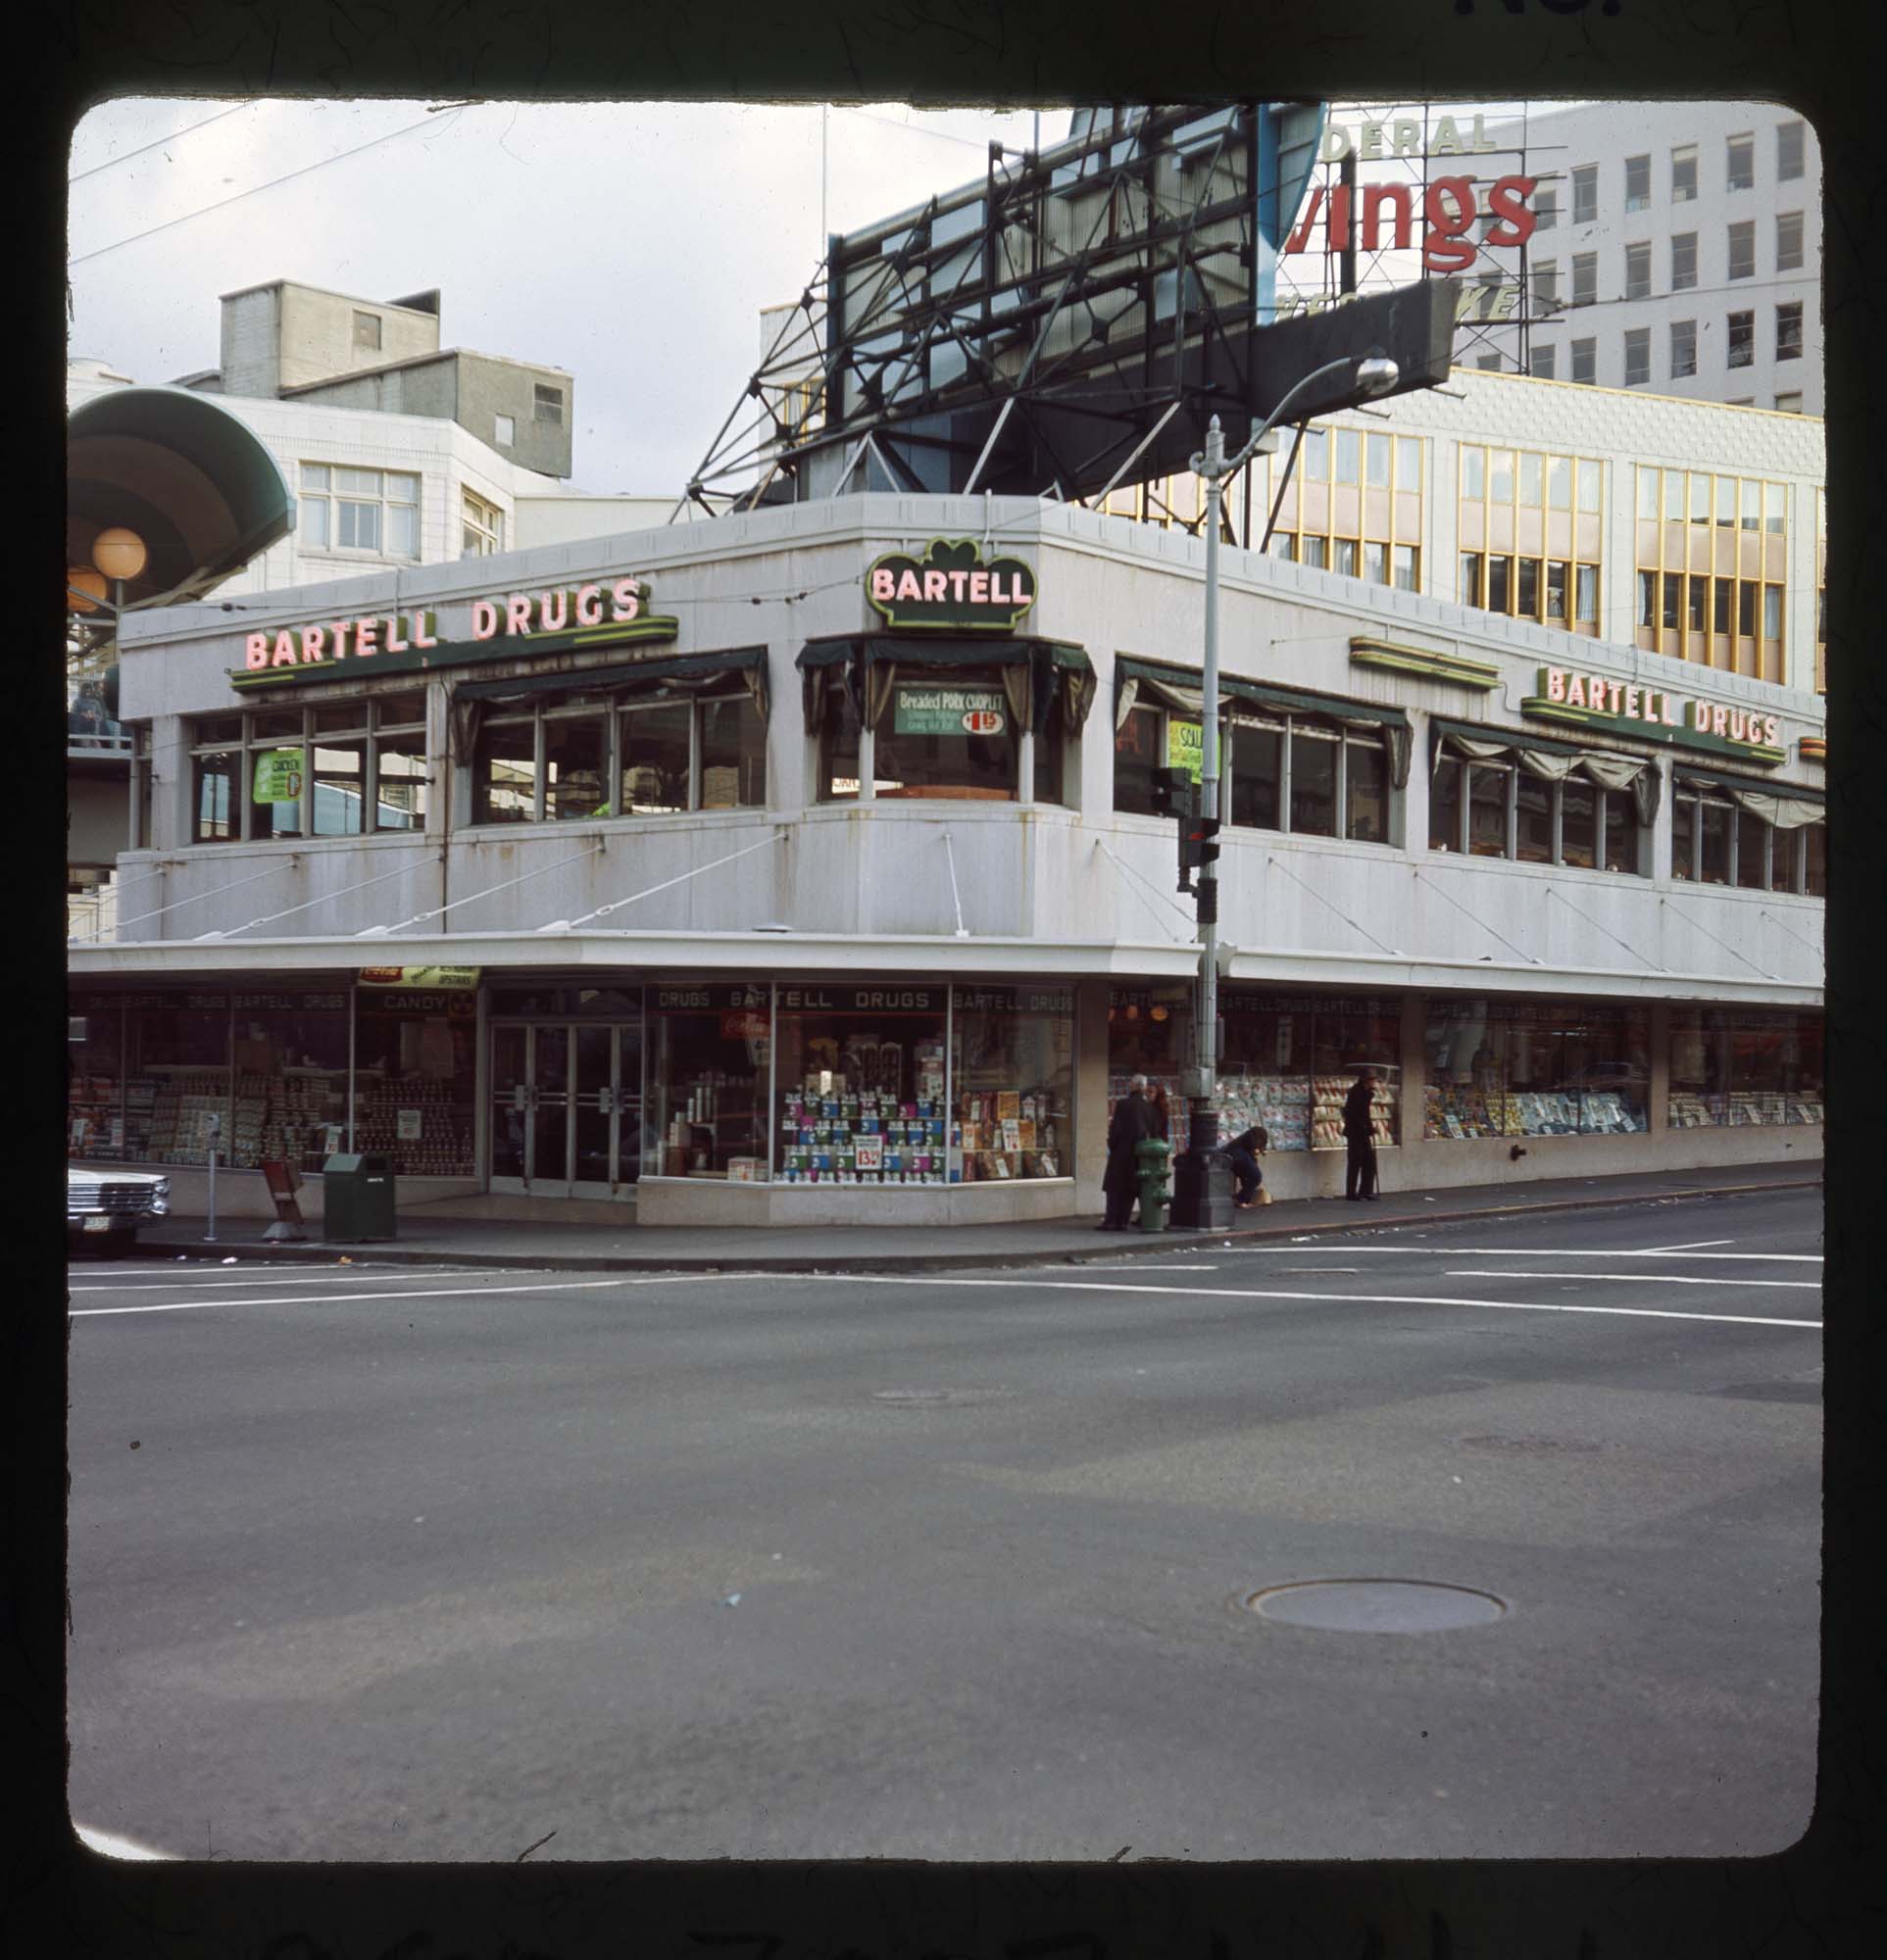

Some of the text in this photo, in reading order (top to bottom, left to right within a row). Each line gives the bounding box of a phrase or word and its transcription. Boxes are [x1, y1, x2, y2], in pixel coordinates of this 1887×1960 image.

[871, 567, 1033, 605] BARTELL
[244, 578, 642, 671] BARTELL DRUGS
[900, 691, 941, 710] Breaded
[1547, 665, 1783, 748] BARTELL DRUGS
[1179, 727, 1205, 750] SOU
[383, 994, 448, 1010] CANDY
[659, 990, 1074, 1012] DRUGS BARTELL DRUGS BARTELL DRUGS
